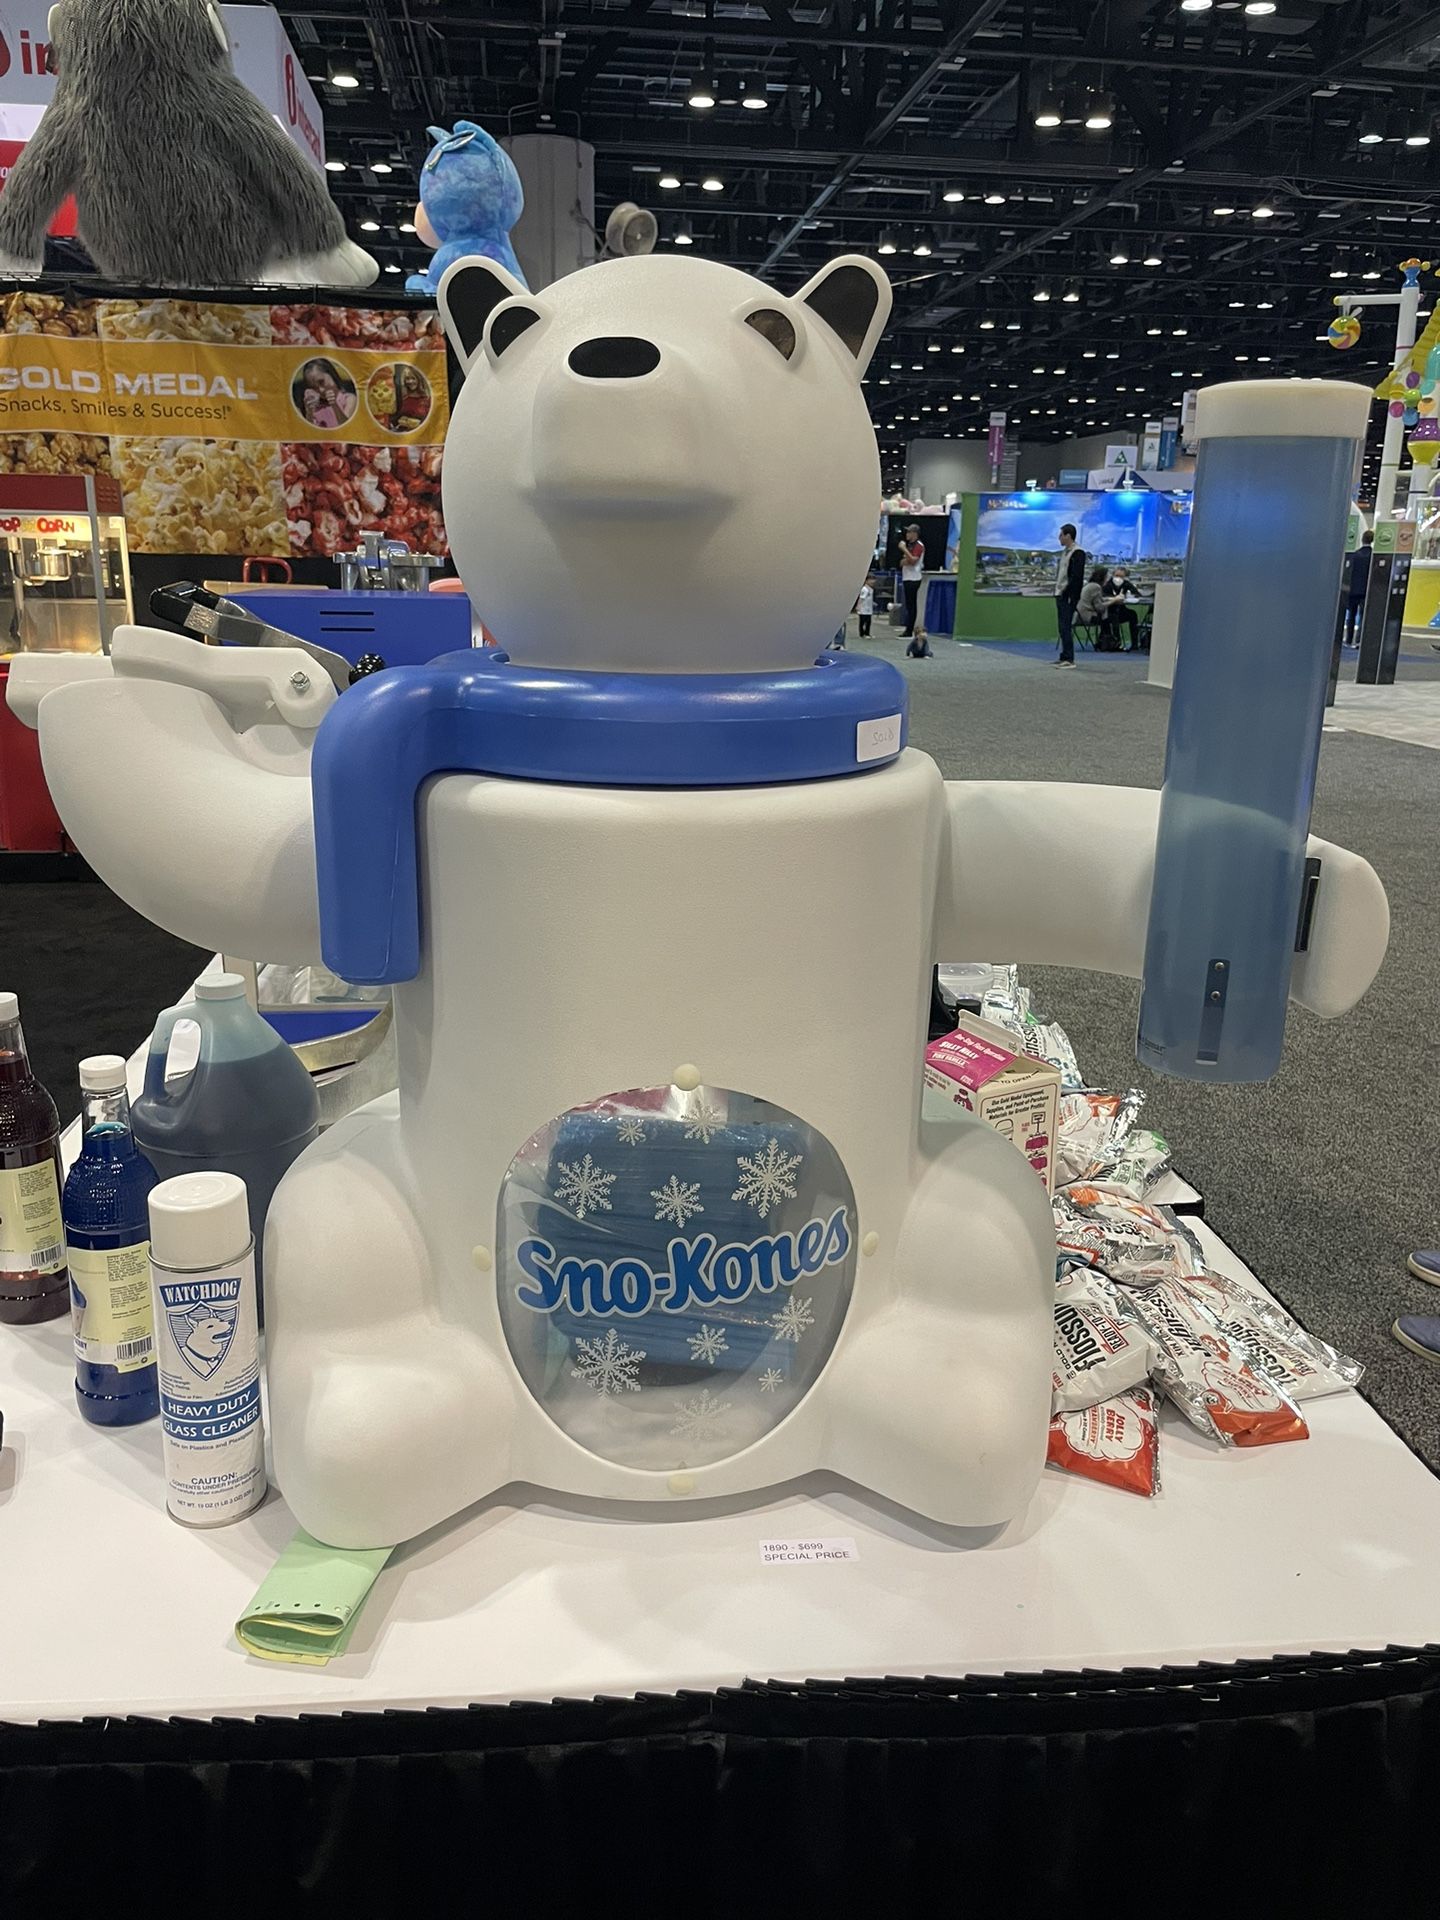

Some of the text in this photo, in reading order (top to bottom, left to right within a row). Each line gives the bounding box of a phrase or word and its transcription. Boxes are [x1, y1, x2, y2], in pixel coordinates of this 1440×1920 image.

[0, 366, 258, 400] GOLD MEDAL
[0, 396, 67, 414] Snacks,
[71, 399, 127, 417] Smiles
[132, 404, 145, 418] &
[515, 1205, 853, 1317] Sno-Kones
[165, 1280, 237, 1303] WATCHDOG
[1056, 1349, 1072, 1370] GOLD
[168, 1390, 251, 1416] HEAVY DUTY
[164, 1406, 258, 1437] GLASS CLEANER
[1090, 1406, 1098, 1443] RAWBERRY
[1105, 1409, 1116, 1442] BERRY
[1115, 1414, 1126, 1442] JOLLY
[191, 1472, 238, 1485] CAUTION:
[202, 1482, 226, 1490] UNDER
[177, 1499, 186, 1507] NET
[763, 1543, 788, 1551] 1890
[798, 1542, 823, 1550] $699
[764, 1551, 850, 1561] SPECIAL PRICE
